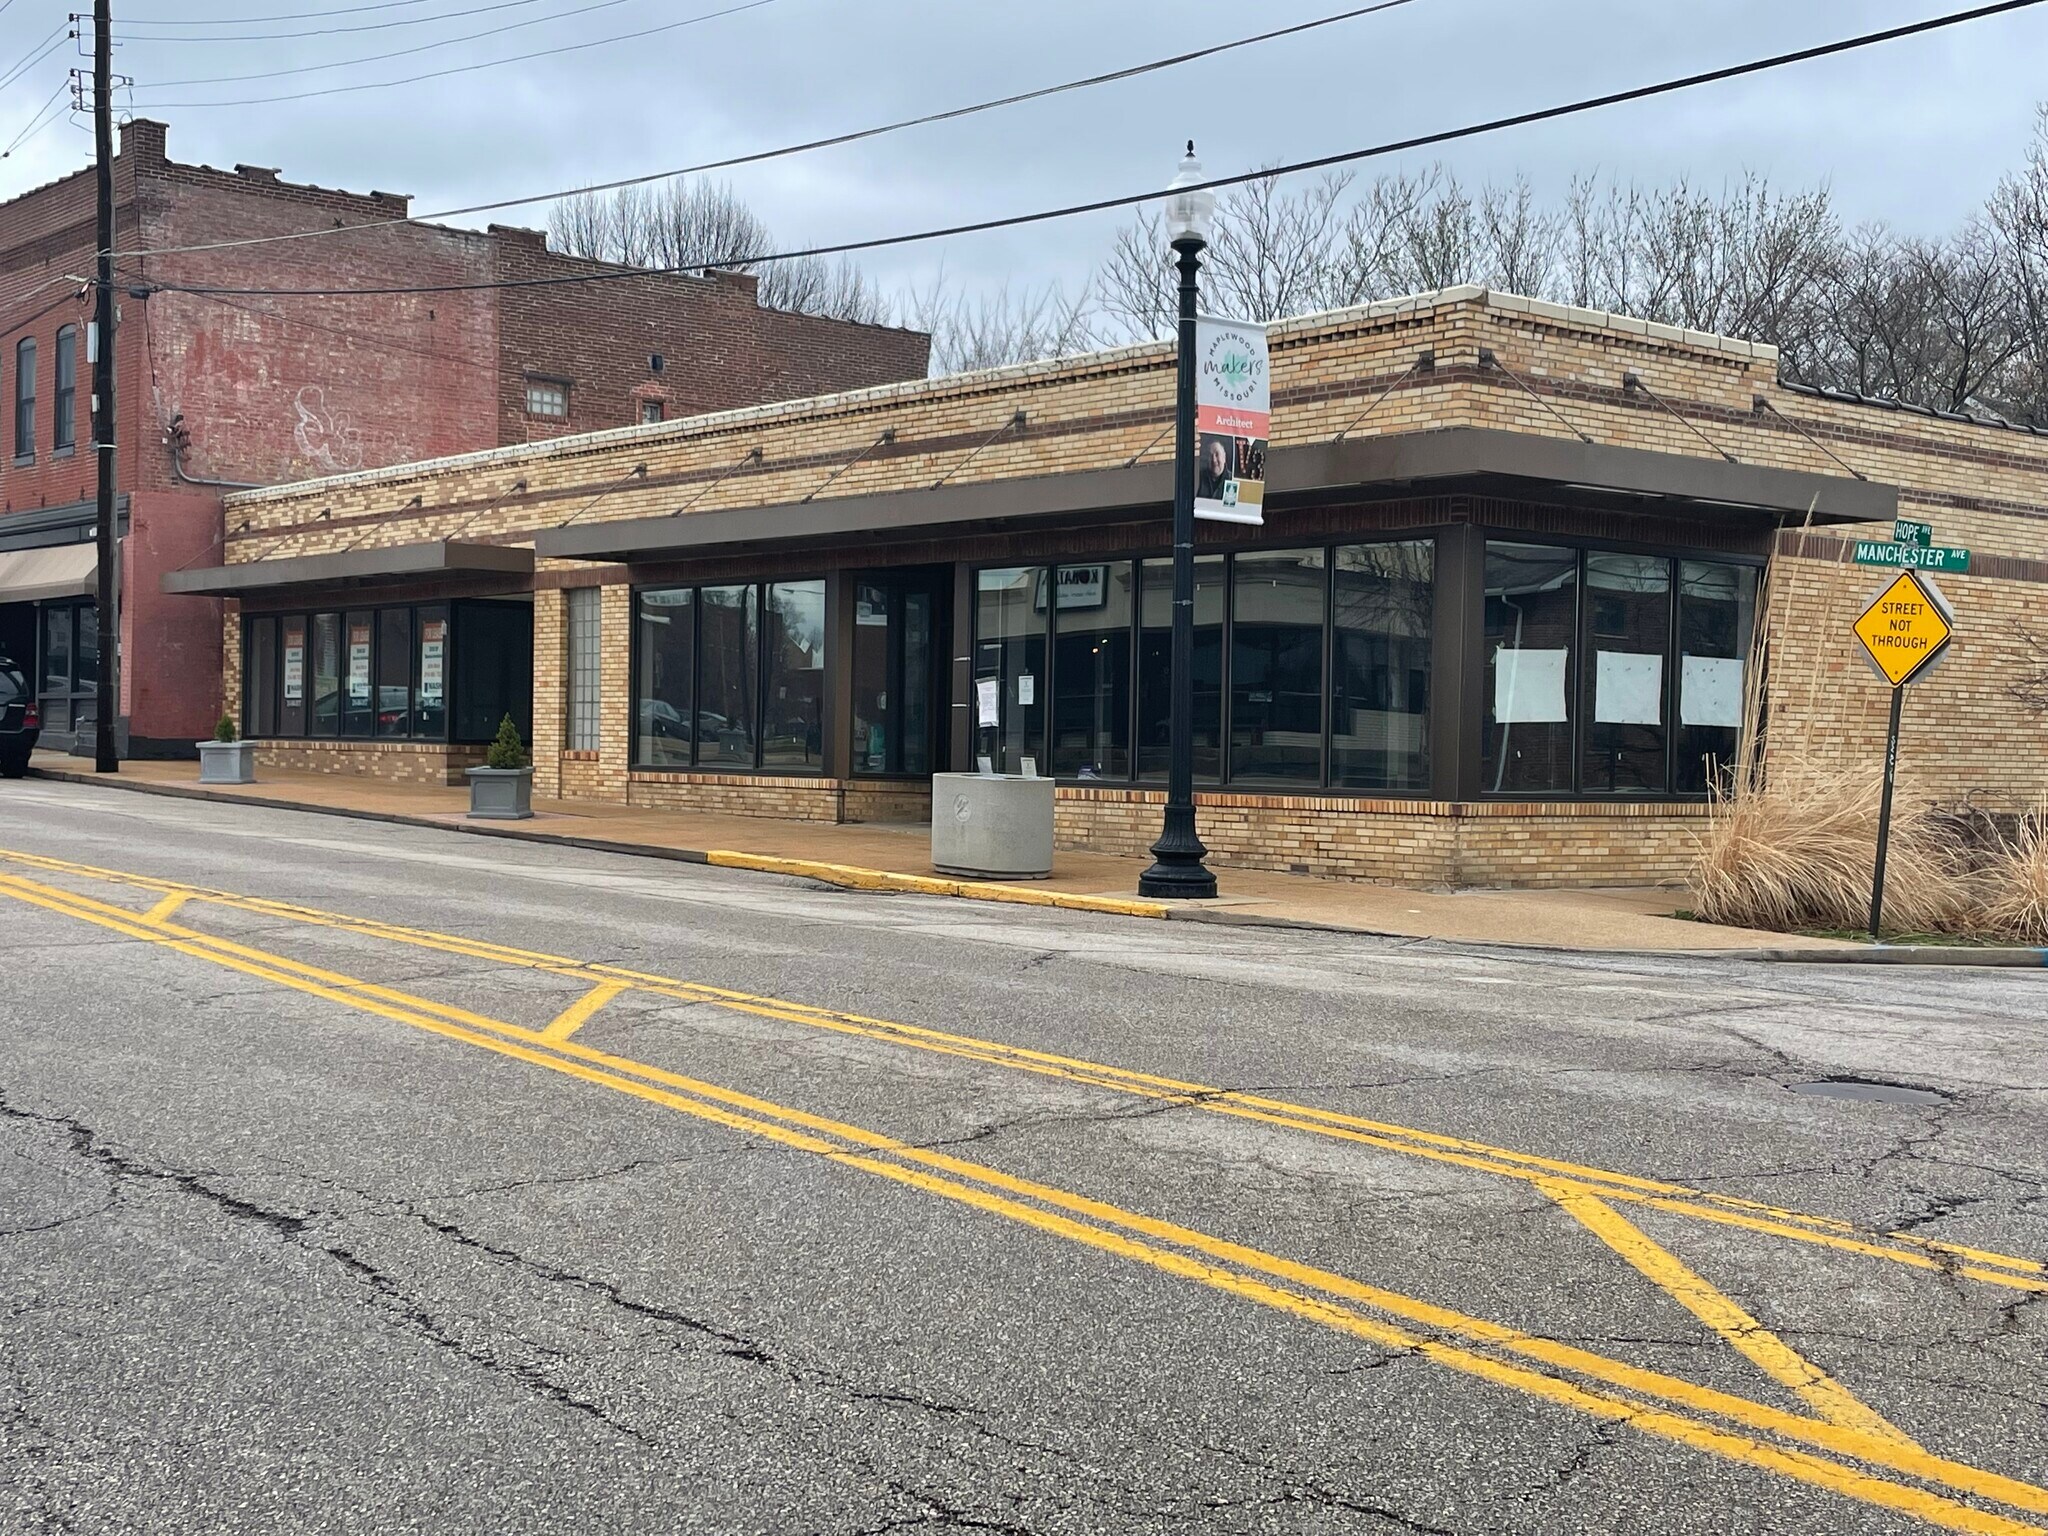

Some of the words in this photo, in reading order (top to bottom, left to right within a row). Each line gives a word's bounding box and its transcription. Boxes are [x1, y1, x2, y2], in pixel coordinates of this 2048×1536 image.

[1209, 332, 1255, 356] MAPLEWOOD
[1203, 353, 1264, 376] makers
[1213, 377, 1257, 401] MISSOURI
[1216, 414, 1253, 429] Architect
[1895, 522, 1920, 542] HOPE
[1921, 525, 1931, 535] AVE
[1857, 543, 1945, 567] MANCHESTER
[1951, 549, 1966, 560] AVE
[1881, 602, 1924, 616] STREET
[1889, 619, 1912, 632] NOT
[1871, 635, 1928, 649] THROUGH
